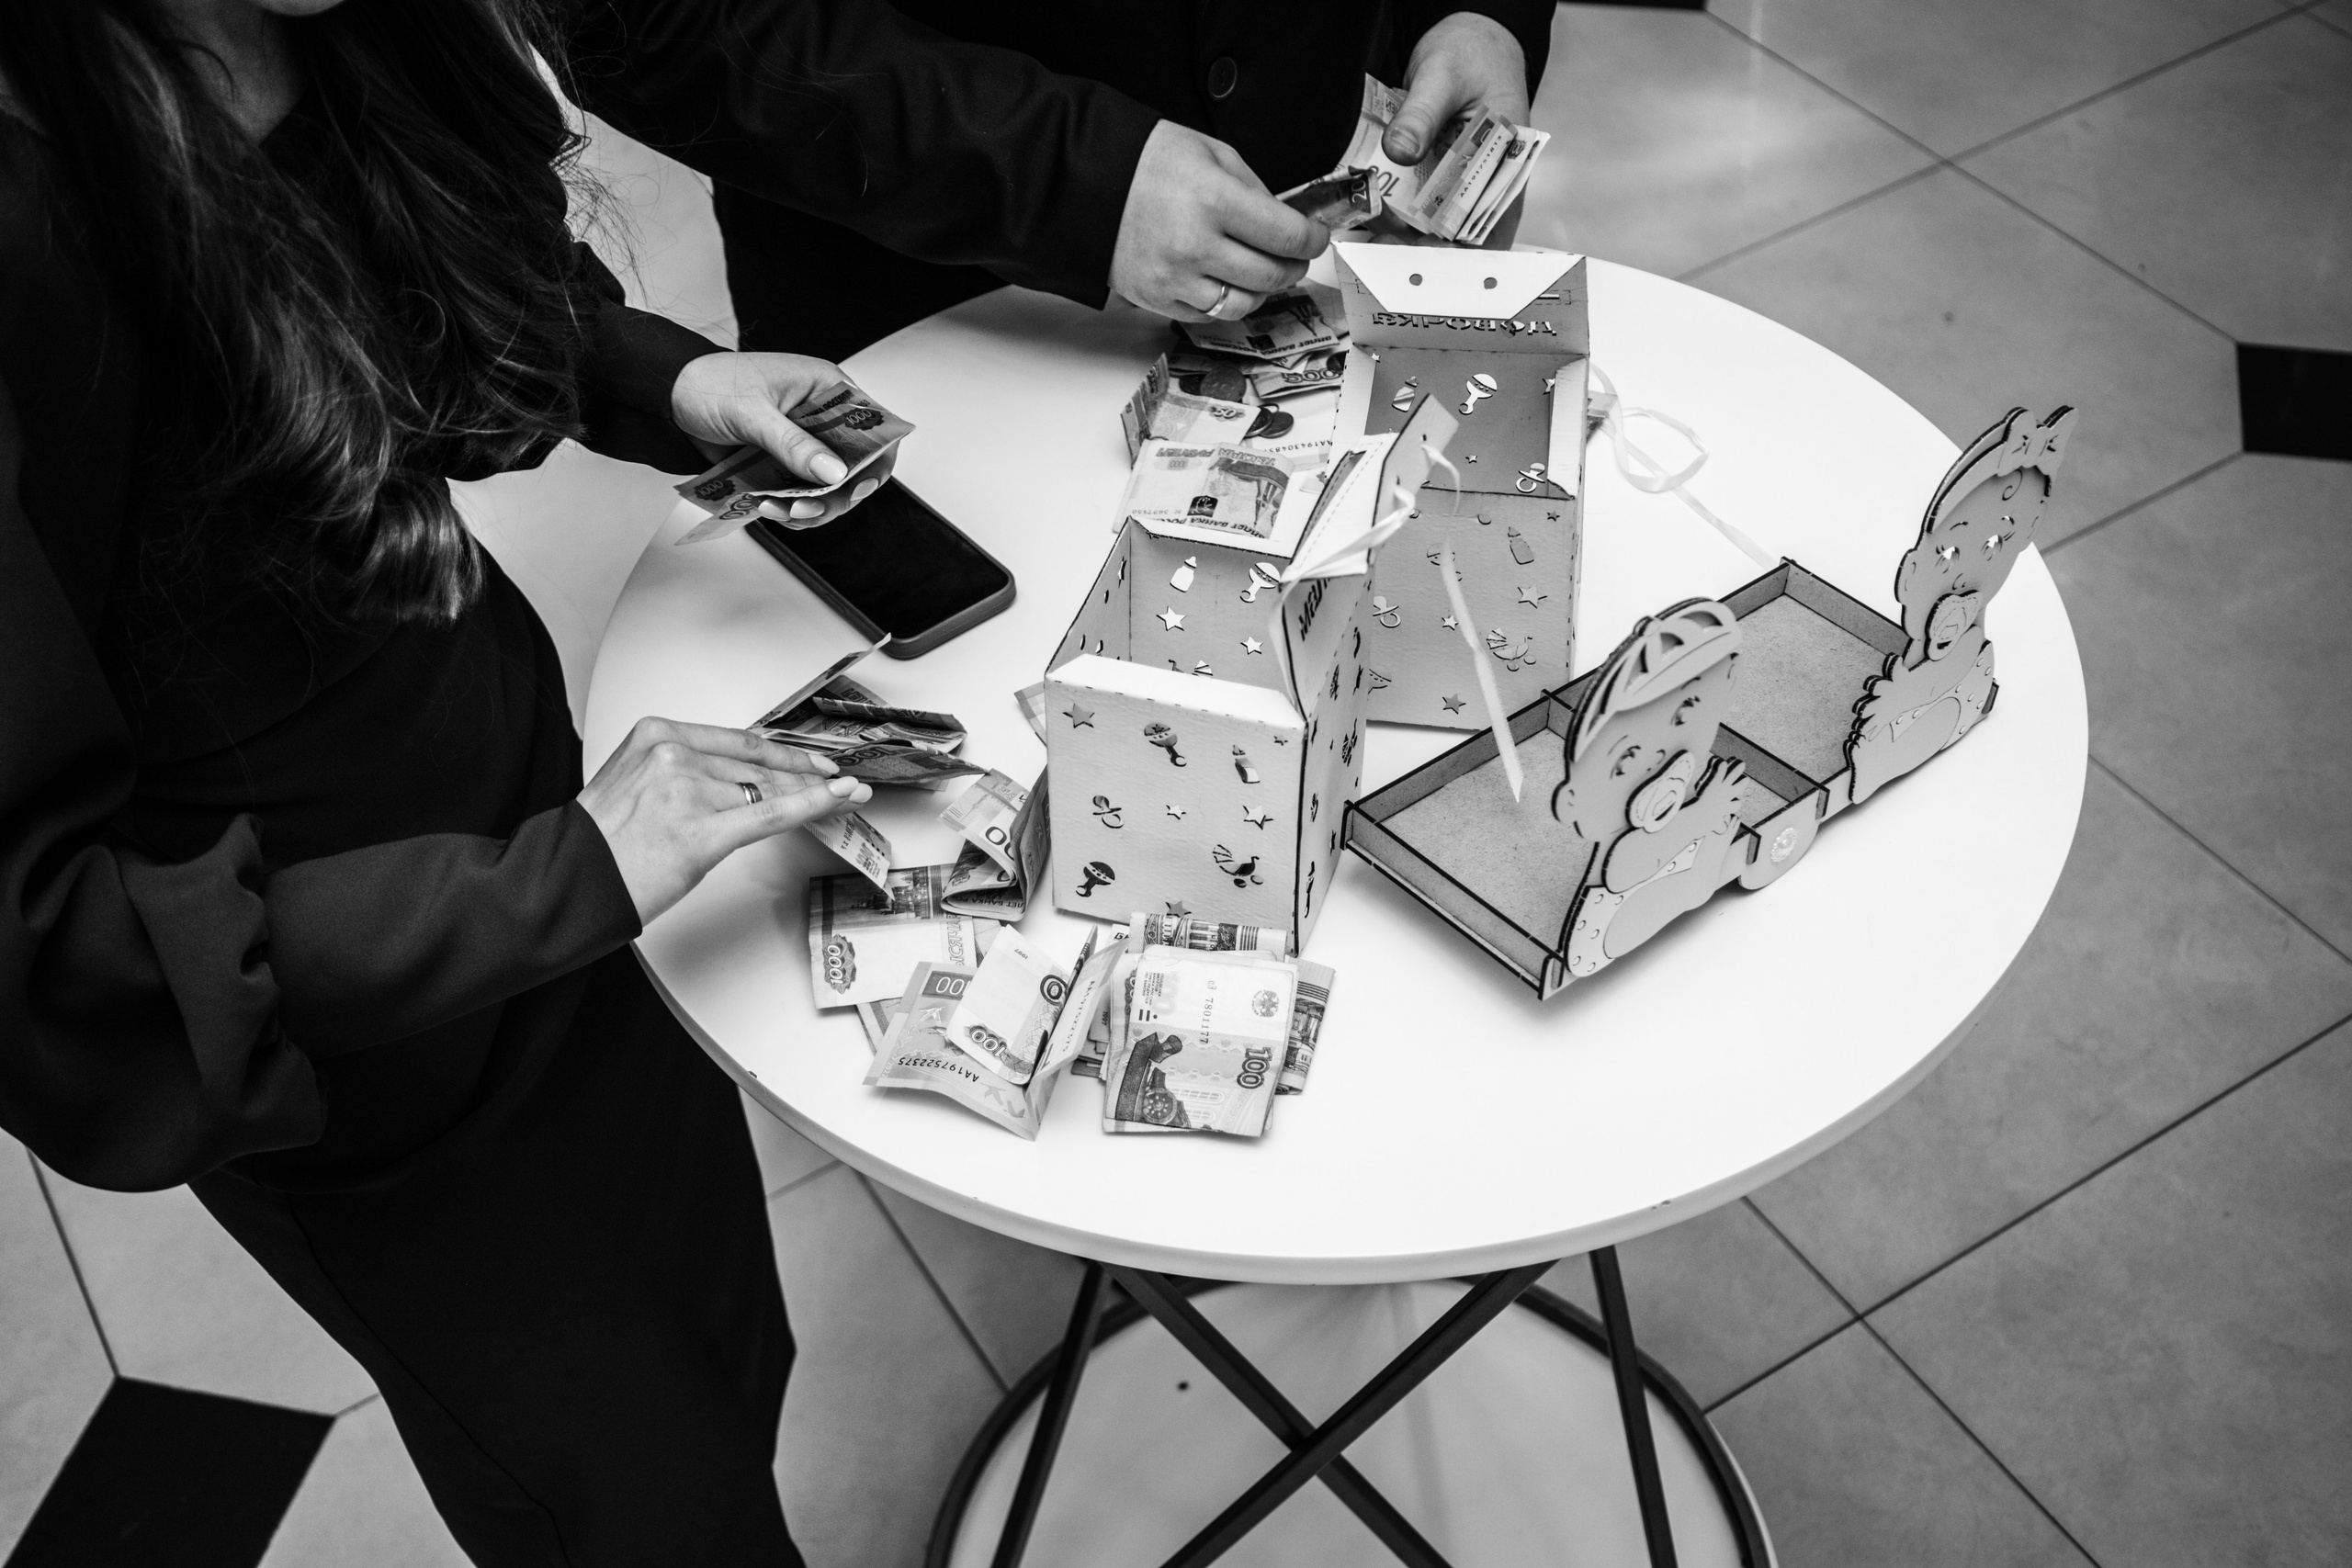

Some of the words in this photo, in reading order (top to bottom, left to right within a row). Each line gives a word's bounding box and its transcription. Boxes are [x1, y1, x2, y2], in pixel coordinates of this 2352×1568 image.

[844, 408, 872, 425] 1000
[697, 479, 724, 496] 1000
[971, 897, 1004, 906] БАНКА
[1013, 948, 1029, 960] 1997
[827, 944, 843, 986] 1000
[1101, 1010, 1109, 1026] 1997
[1199, 997, 1214, 1044] 7801177
[971, 1030, 1007, 1057] 100
[898, 1056, 980, 1082] AA197522375
[1237, 1046, 1273, 1089] 100
